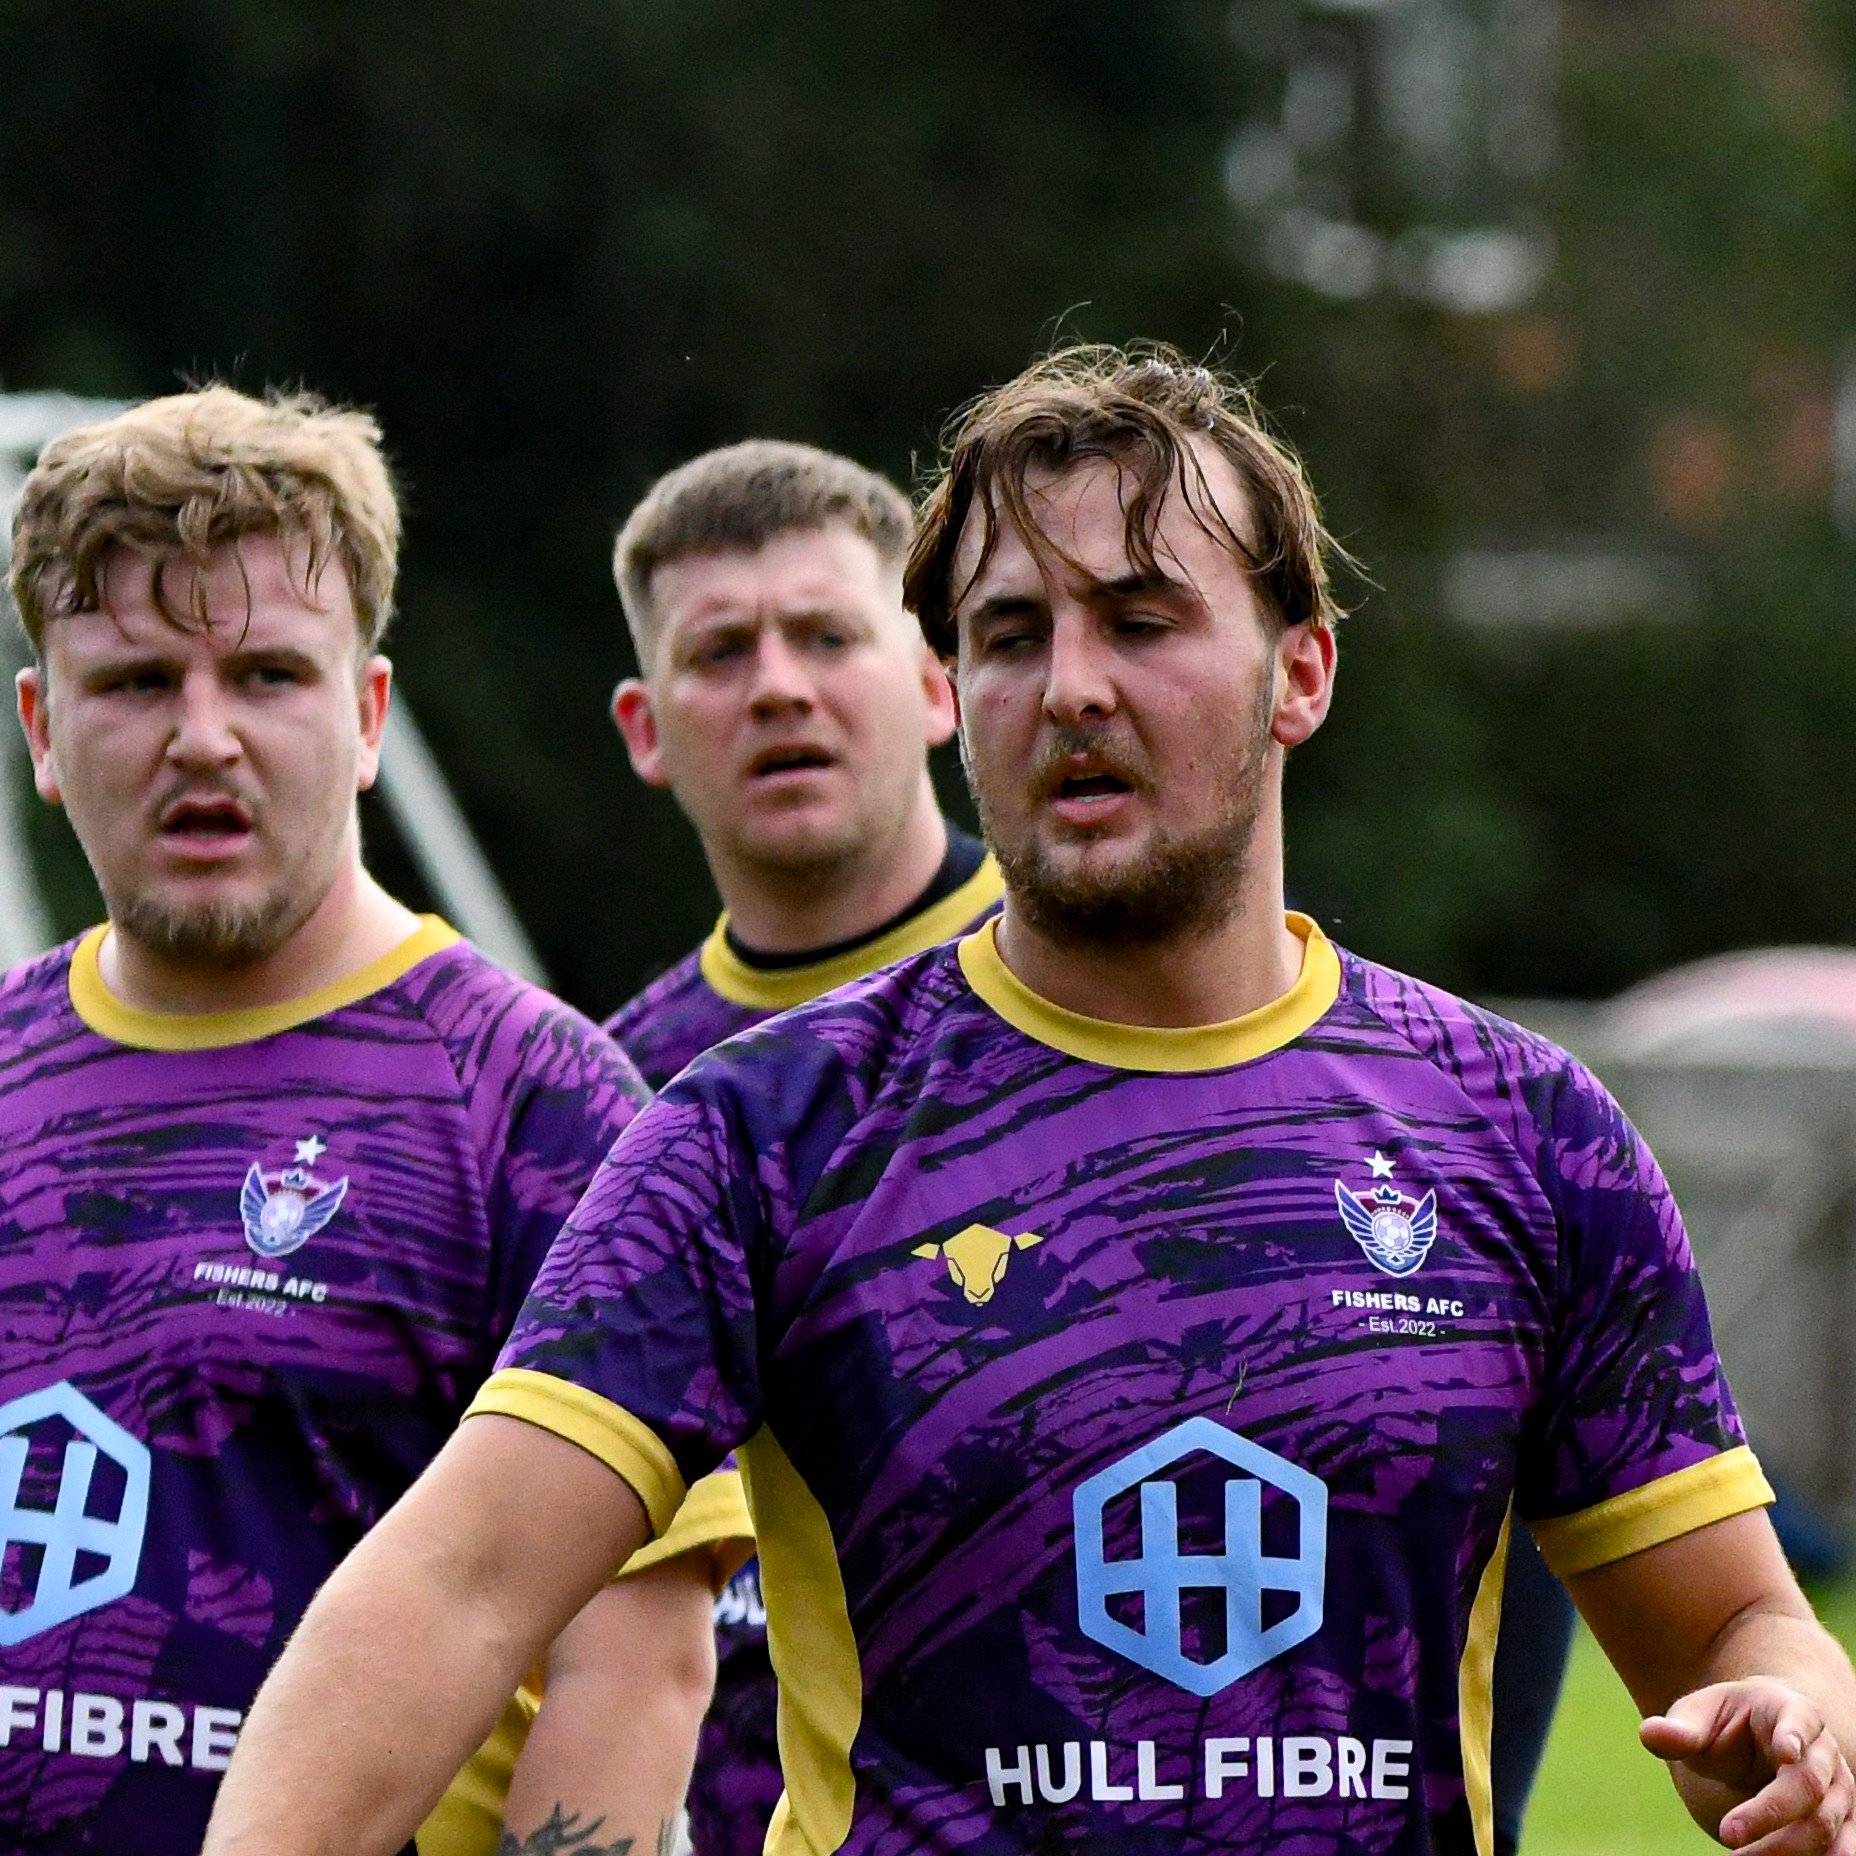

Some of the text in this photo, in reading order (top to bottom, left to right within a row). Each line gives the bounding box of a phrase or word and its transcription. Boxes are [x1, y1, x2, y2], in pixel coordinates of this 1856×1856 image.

[283, 1276, 327, 1303] AFC
[1331, 1289, 1464, 1317] FISHERS AFC
[0, 1685, 242, 1771] FIBRE
[985, 1737, 1413, 1807] HULL FIBRE
